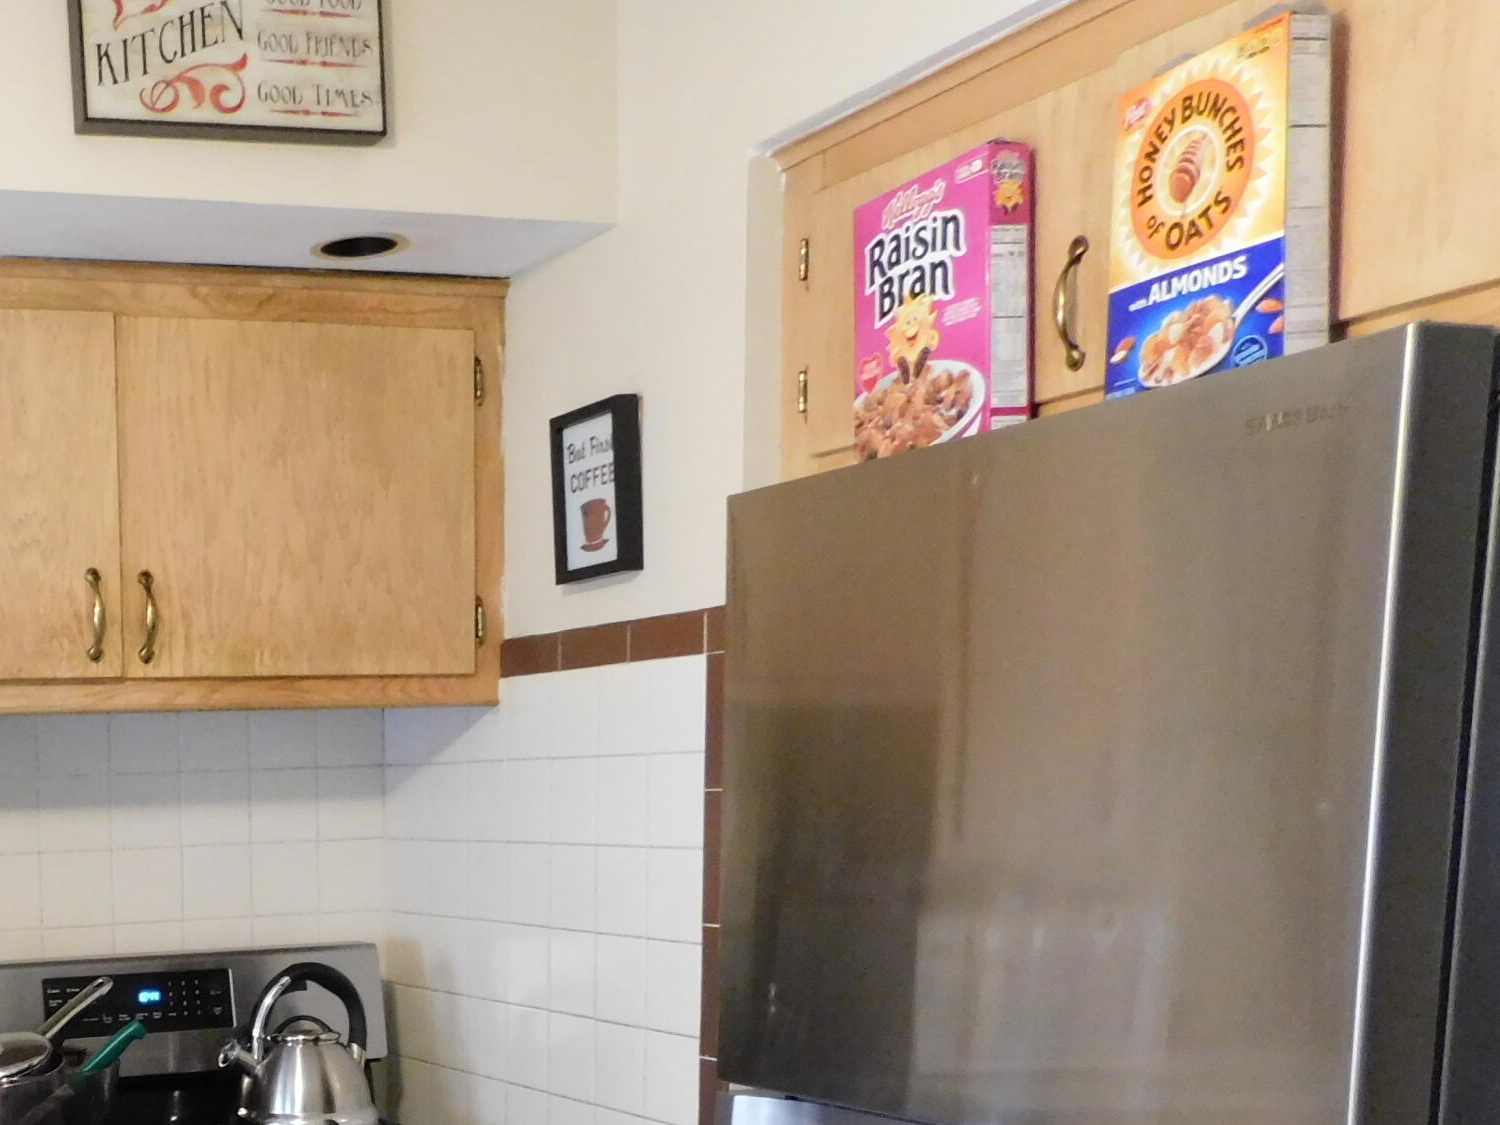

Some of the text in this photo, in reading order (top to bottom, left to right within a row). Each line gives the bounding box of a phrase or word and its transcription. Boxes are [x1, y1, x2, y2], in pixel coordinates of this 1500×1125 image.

[96, 0, 244, 87] KITCHEN
[257, 29, 298, 54] GOOD
[257, 81, 303, 105] GOOD
[1137, 91, 1245, 208] HONEY BUNCHES
[867, 213, 962, 288] Raisin
[1164, 190, 1233, 251] OATS
[877, 257, 952, 323] Bran
[1148, 255, 1248, 306] ALMONDS
[570, 462, 614, 493] COFFEE
